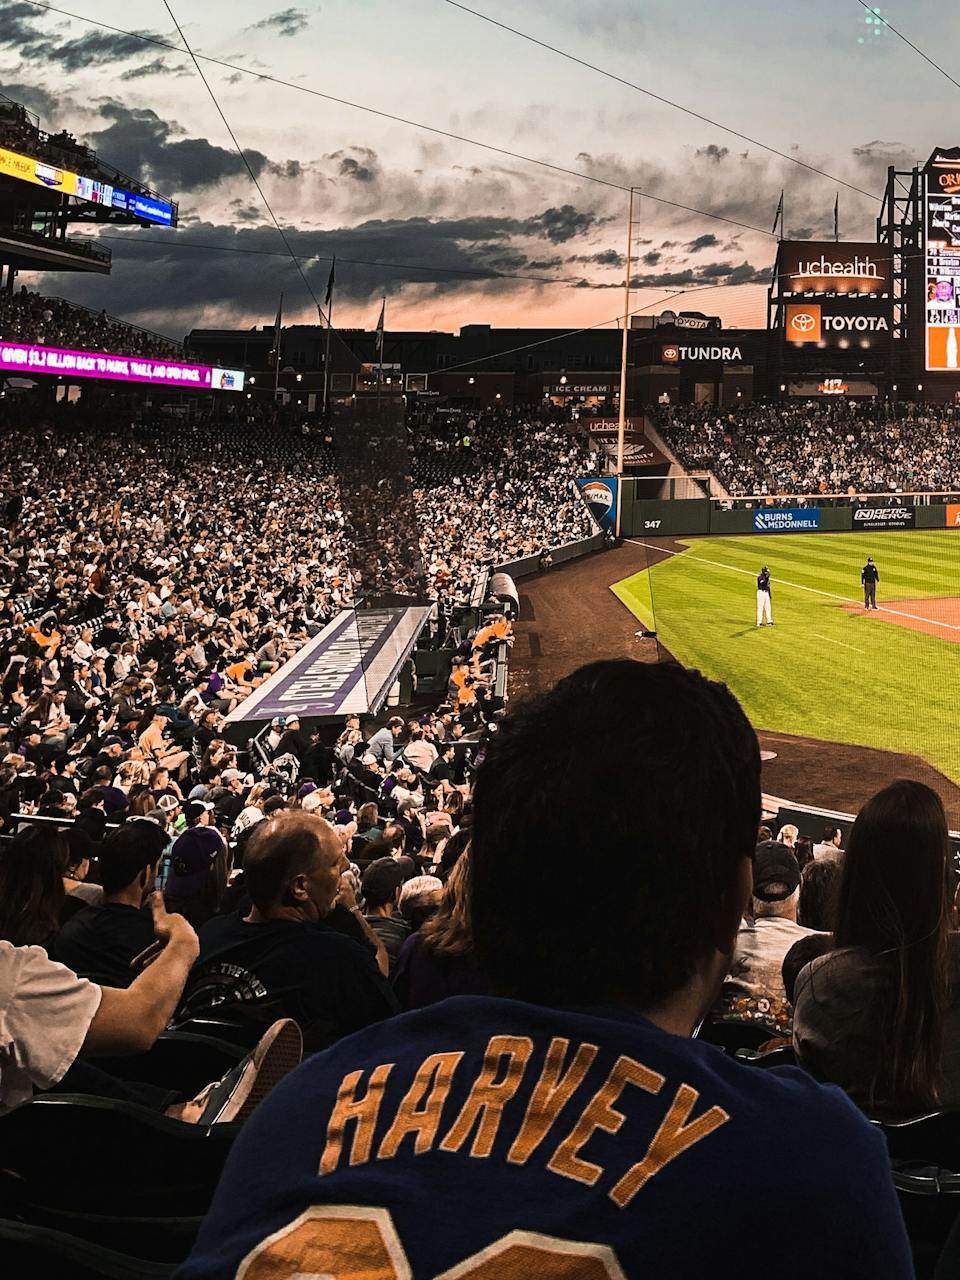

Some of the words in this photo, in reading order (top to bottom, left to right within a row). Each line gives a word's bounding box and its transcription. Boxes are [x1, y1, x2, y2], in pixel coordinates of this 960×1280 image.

[798, 255, 877, 277] uchealth
[822, 316, 889, 331] TOYOTA
[47, 352, 76, 368] BILLION
[679, 347, 742, 360] TUNDRA
[644, 520, 661, 528] 347
[278, 674, 350, 700] FIELD
[319, 1035, 729, 1209] HARVEY
